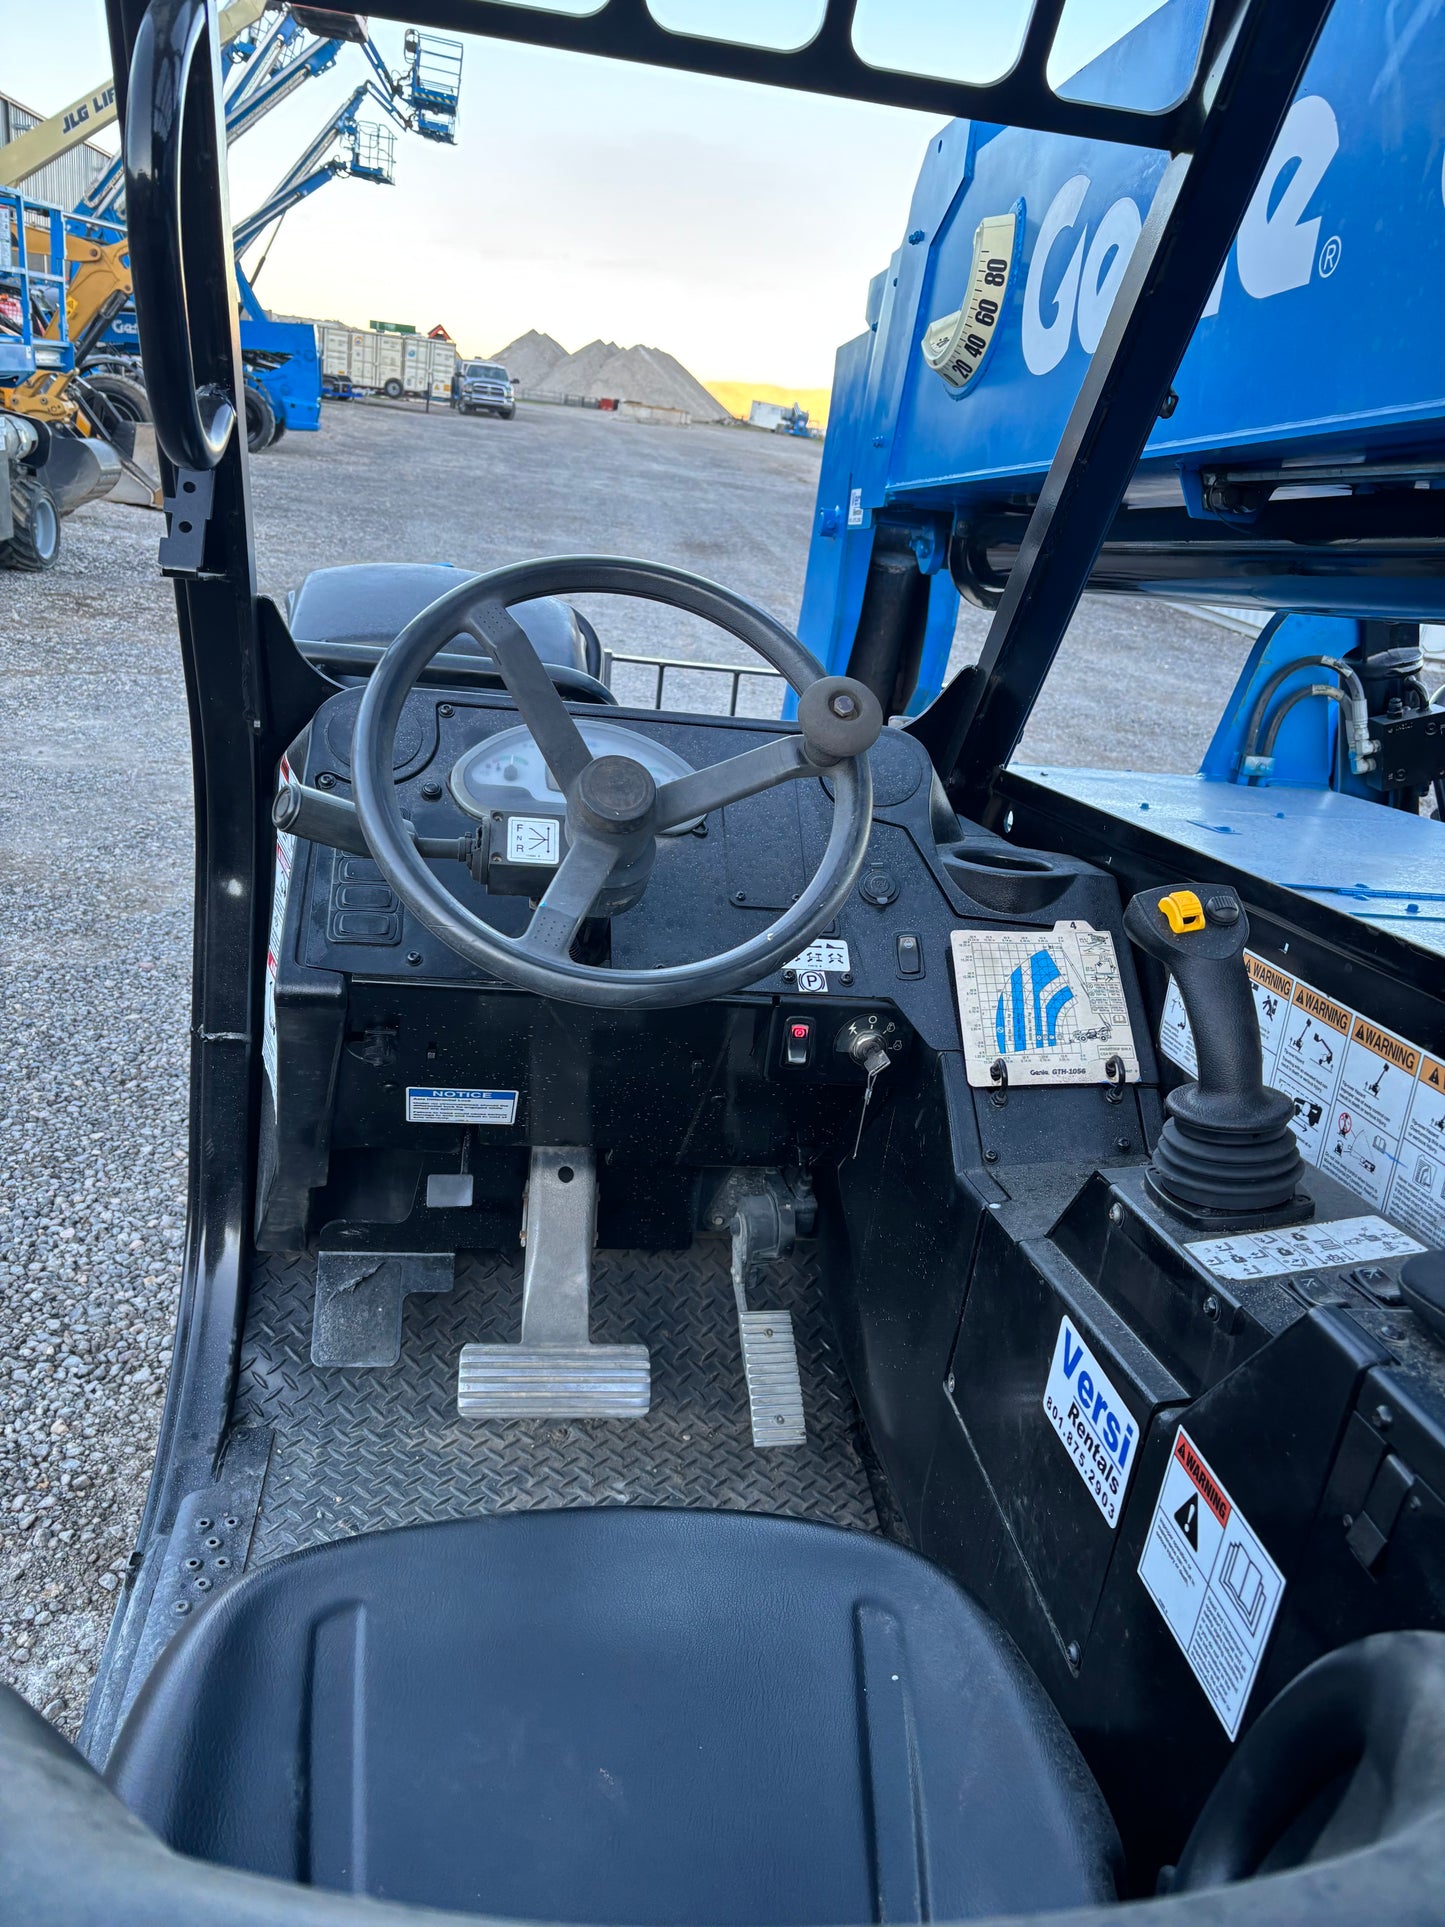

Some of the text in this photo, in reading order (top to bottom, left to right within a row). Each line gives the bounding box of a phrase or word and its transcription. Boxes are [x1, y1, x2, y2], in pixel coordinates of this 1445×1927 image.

[63, 87, 115, 134] JLG LIF
[1022, 95, 1339, 376] Gee
[984, 258, 1008, 286] 80
[975, 298, 998, 326] 60
[964, 334, 986, 358] 40
[952, 359, 973, 380] 20
[516, 824, 524, 832] F
[516, 844, 524, 852] R
[1070, 922, 1076, 930] 4
[1254, 962, 1290, 995] WARNING
[1305, 992, 1348, 1030] WARNING
[1366, 1028, 1414, 1070] WARNING
[432, 1090, 492, 1098] NOTICE
[1064, 1326, 1133, 1469] Versi
[1046, 1396, 1115, 1520] 801.875.2903
[1068, 1402, 1120, 1495] Rentals
[1186, 1452, 1226, 1520] WARNING
